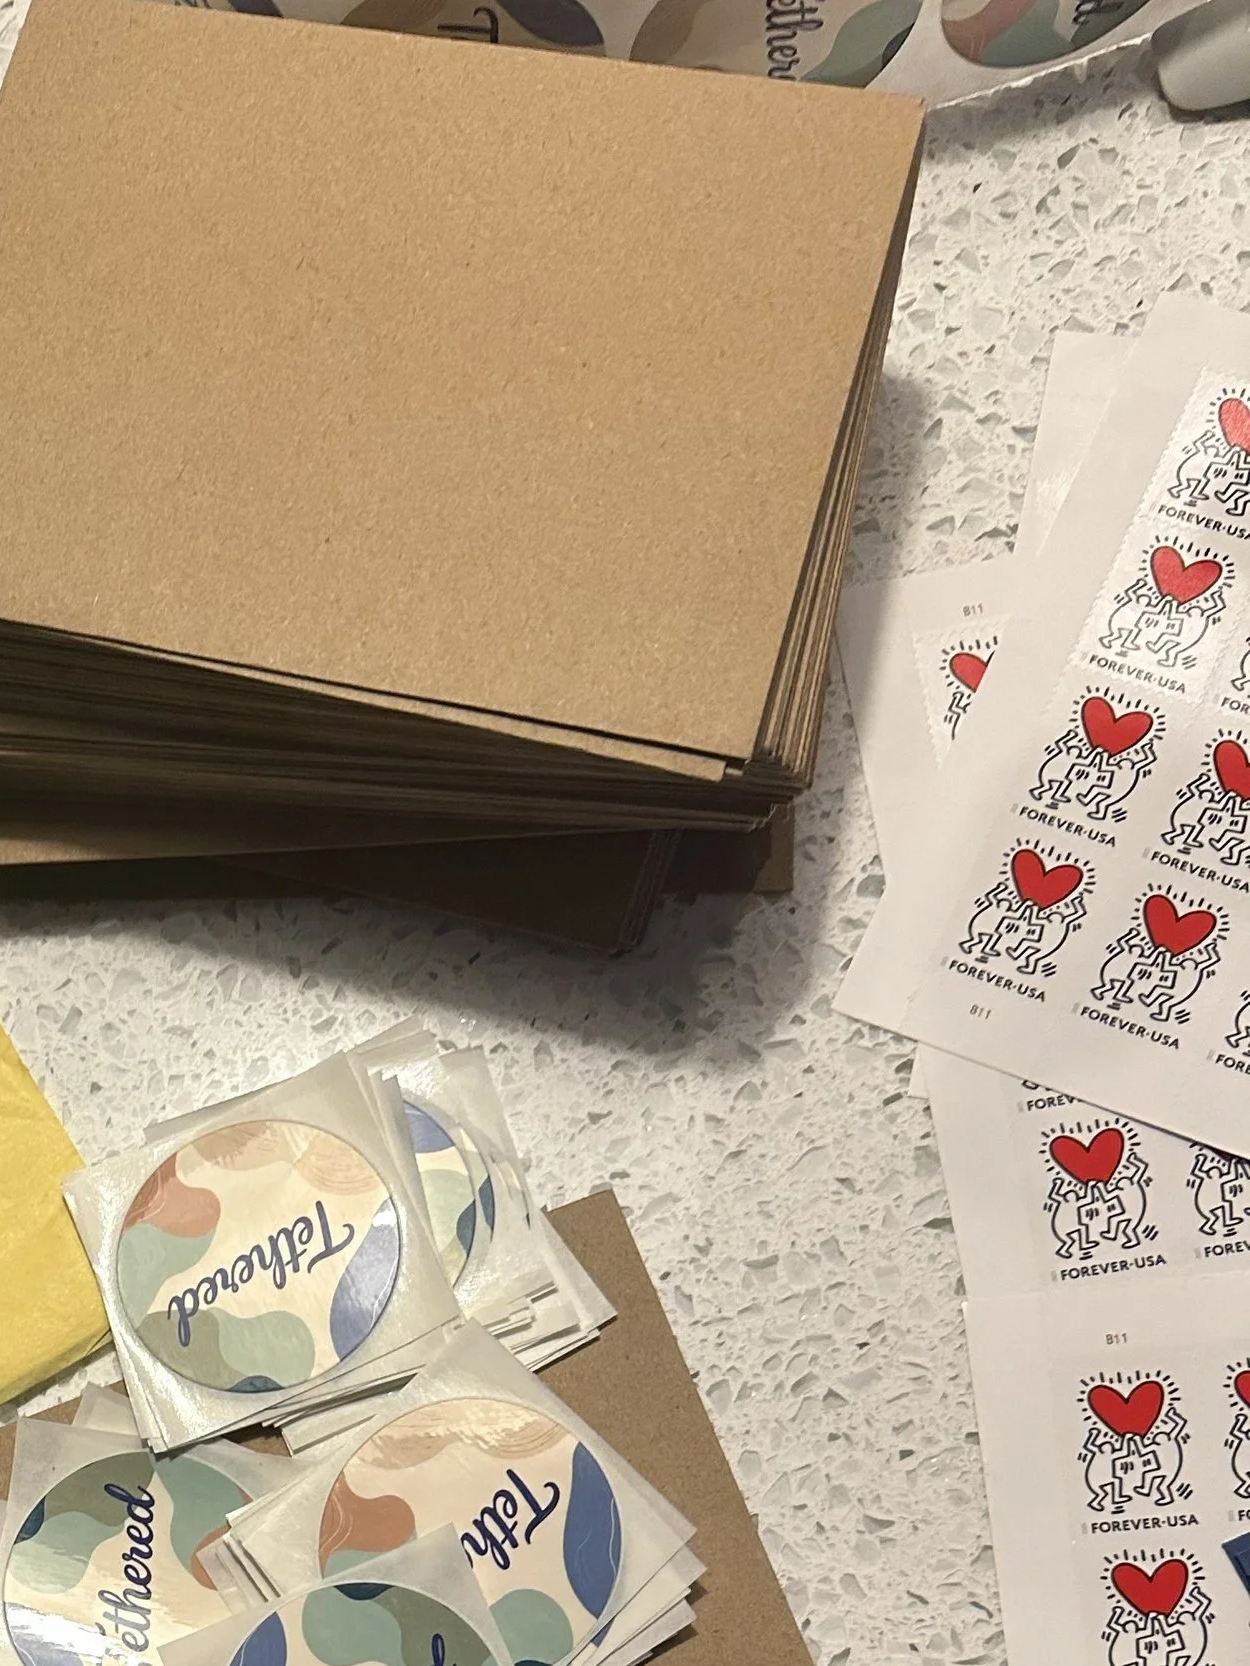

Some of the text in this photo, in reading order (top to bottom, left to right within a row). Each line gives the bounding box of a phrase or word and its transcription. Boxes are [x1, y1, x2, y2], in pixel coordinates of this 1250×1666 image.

[962, 602, 983, 617] B11
[969, 1004, 992, 1020] B11
[167, 1200, 354, 1347] Tethered
[1105, 1332, 1128, 1345] B11
